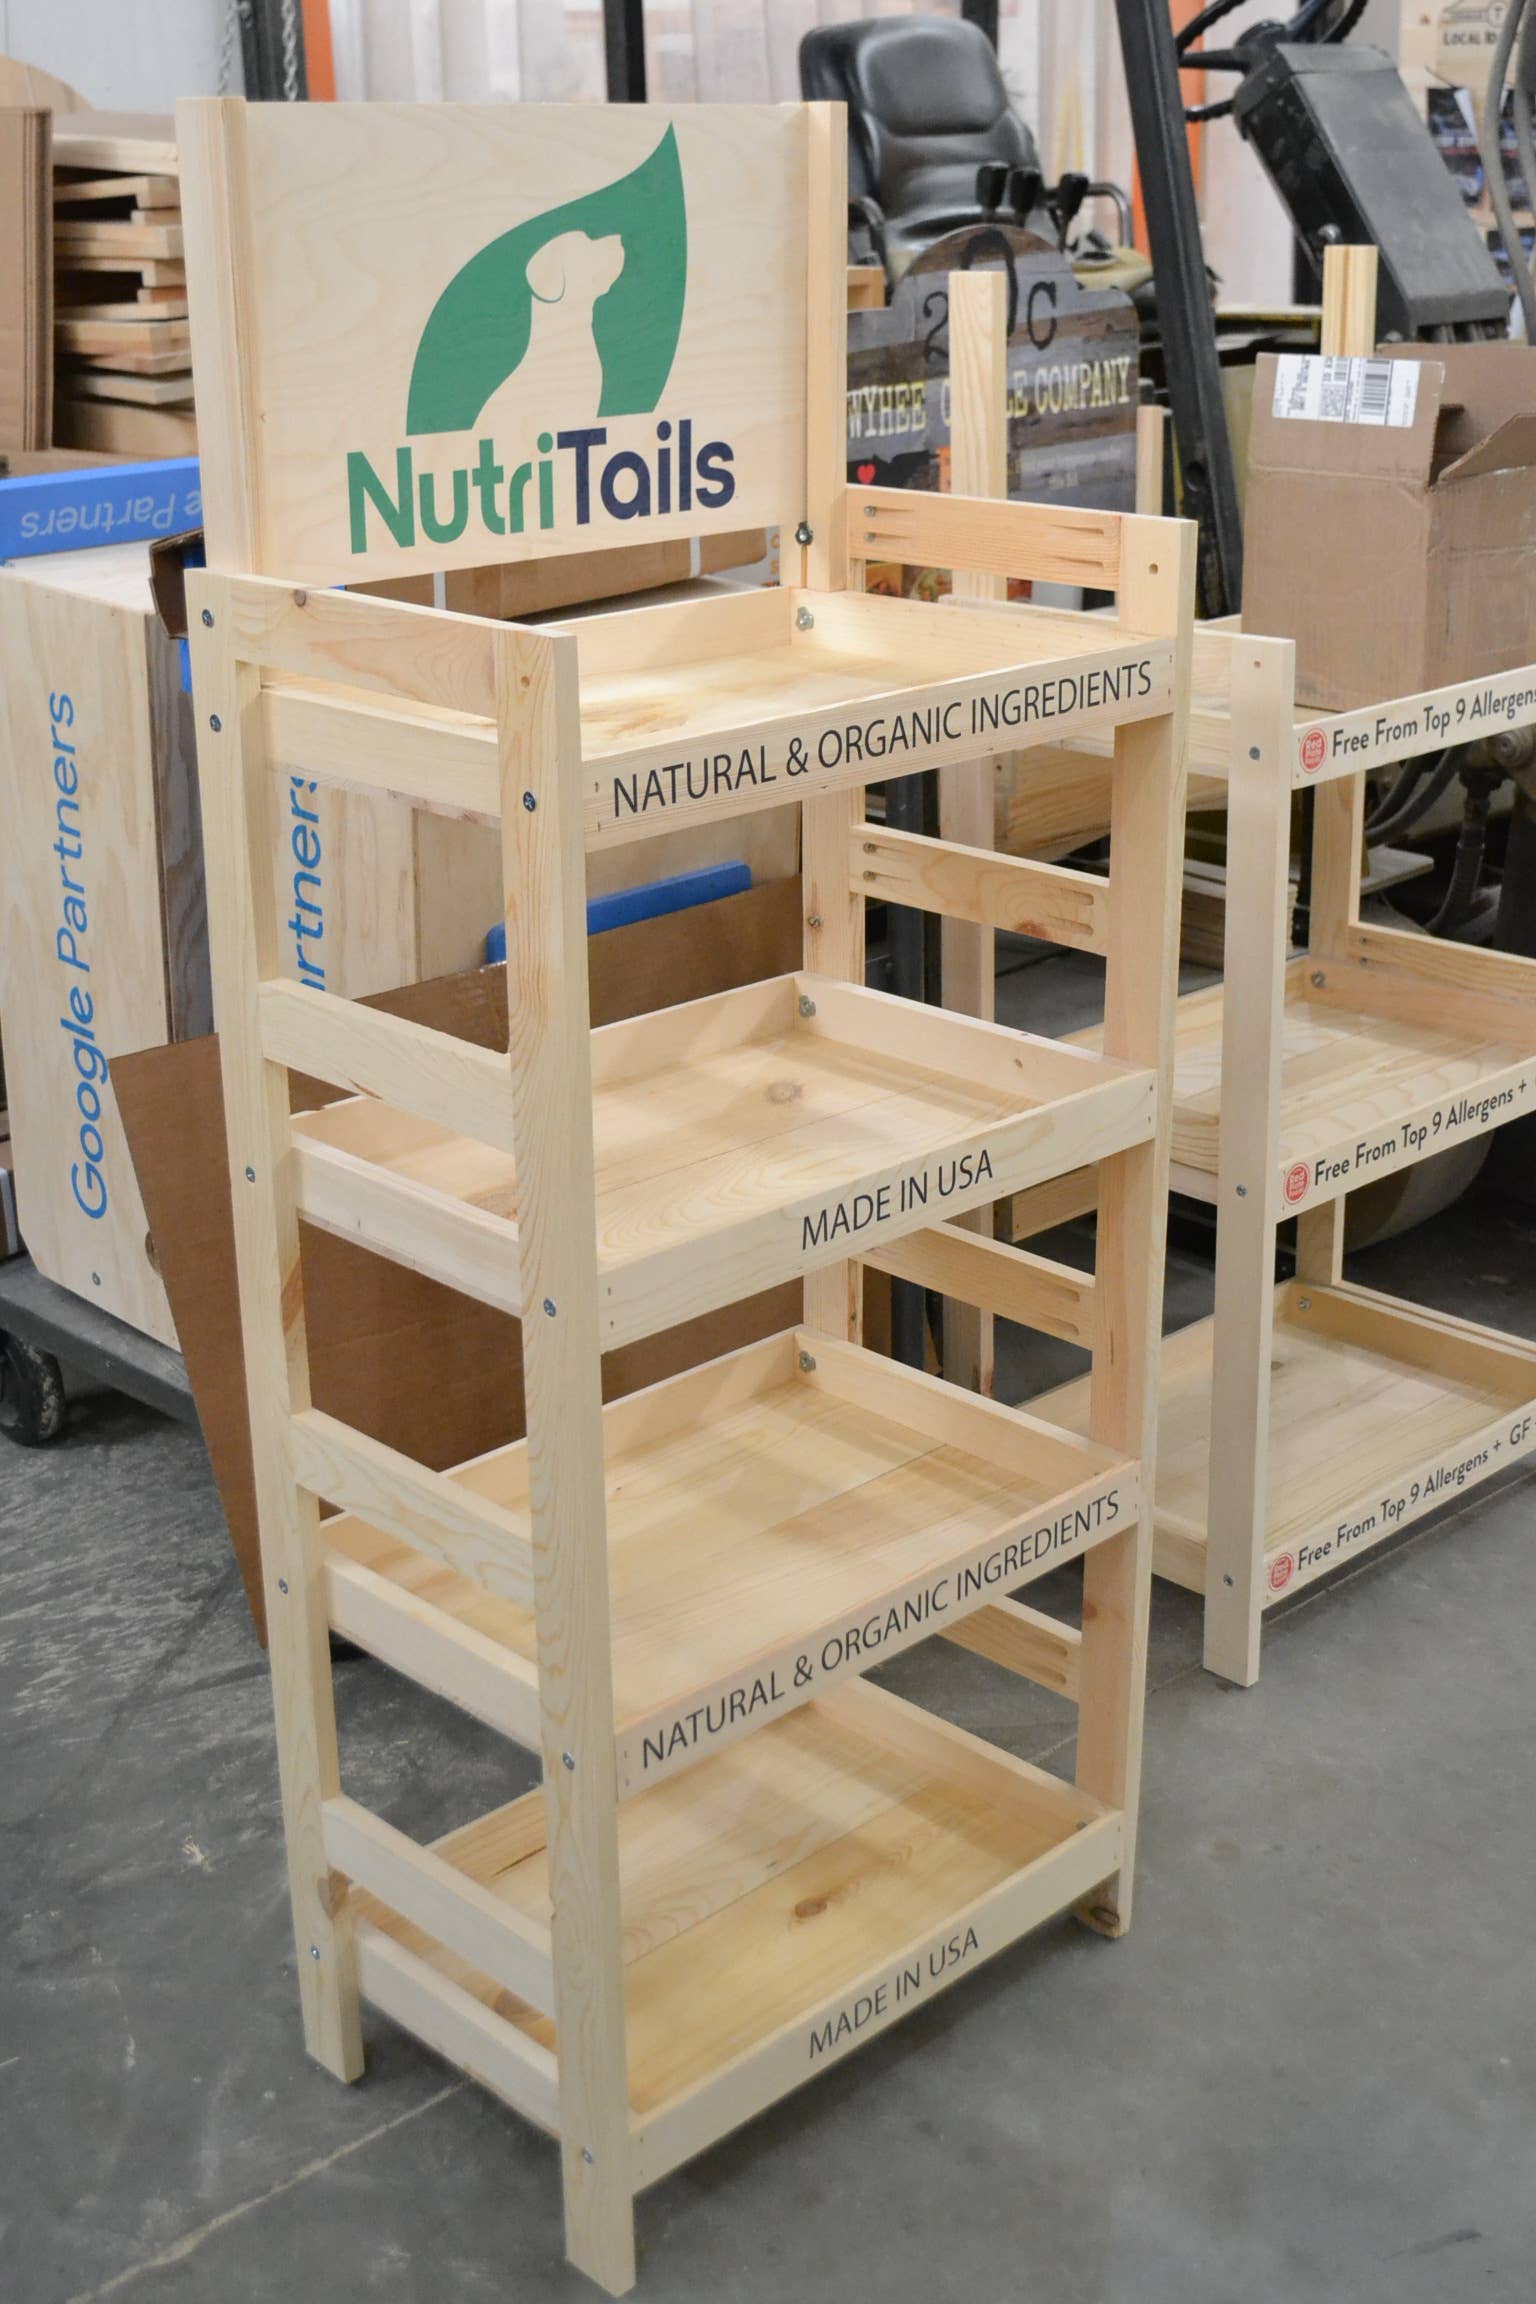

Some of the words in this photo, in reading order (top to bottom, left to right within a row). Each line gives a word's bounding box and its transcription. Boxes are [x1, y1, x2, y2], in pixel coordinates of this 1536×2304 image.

[847, 380, 926, 439] WYHEE
[1034, 356, 1131, 415] COMPANY
[20, 492, 177, 539] Partners
[346, 418, 736, 555] NutriTails
[613, 744, 777, 818] NATURAL
[785, 736, 809, 776] &
[817, 701, 962, 769] ORGANIC
[971, 660, 1151, 735] INGREDIENTS
[1332, 729, 1369, 757] Free
[1375, 717, 1418, 745] From
[1423, 705, 1451, 737] Top
[1456, 698, 1466, 723] 9
[1469, 688, 1536, 720] Allergen
[49, 690, 90, 974] Partners
[287, 775, 326, 992] rtner
[60, 985, 109, 1220] Google
[1314, 1159, 1350, 1186] Free
[1355, 1138, 1396, 1169] From
[1401, 1123, 1428, 1151] Top
[1432, 1111, 1442, 1136] 9
[1446, 1088, 1514, 1130] Allergens
[802, 1184, 891, 1251] MADE
[900, 1171, 928, 1213] IN
[938, 1149, 993, 1197] USA
[1297, 1540, 1332, 1571] Free
[1336, 1515, 1376, 1548] From
[1380, 1498, 1405, 1521] Top
[1410, 1483, 1420, 1505] 9
[1423, 1450, 1489, 1498] Allergens
[1509, 1415, 1532, 1446] GF
[642, 1670, 785, 1769] NATURAL
[793, 1654, 813, 1687] &
[821, 1580, 949, 1671] ORGANIC
[957, 1489, 1119, 1601] INGREDIENTS
[809, 1983, 888, 2059] MADE
[896, 1961, 920, 2001] IN
[929, 1926, 979, 1977] USA
